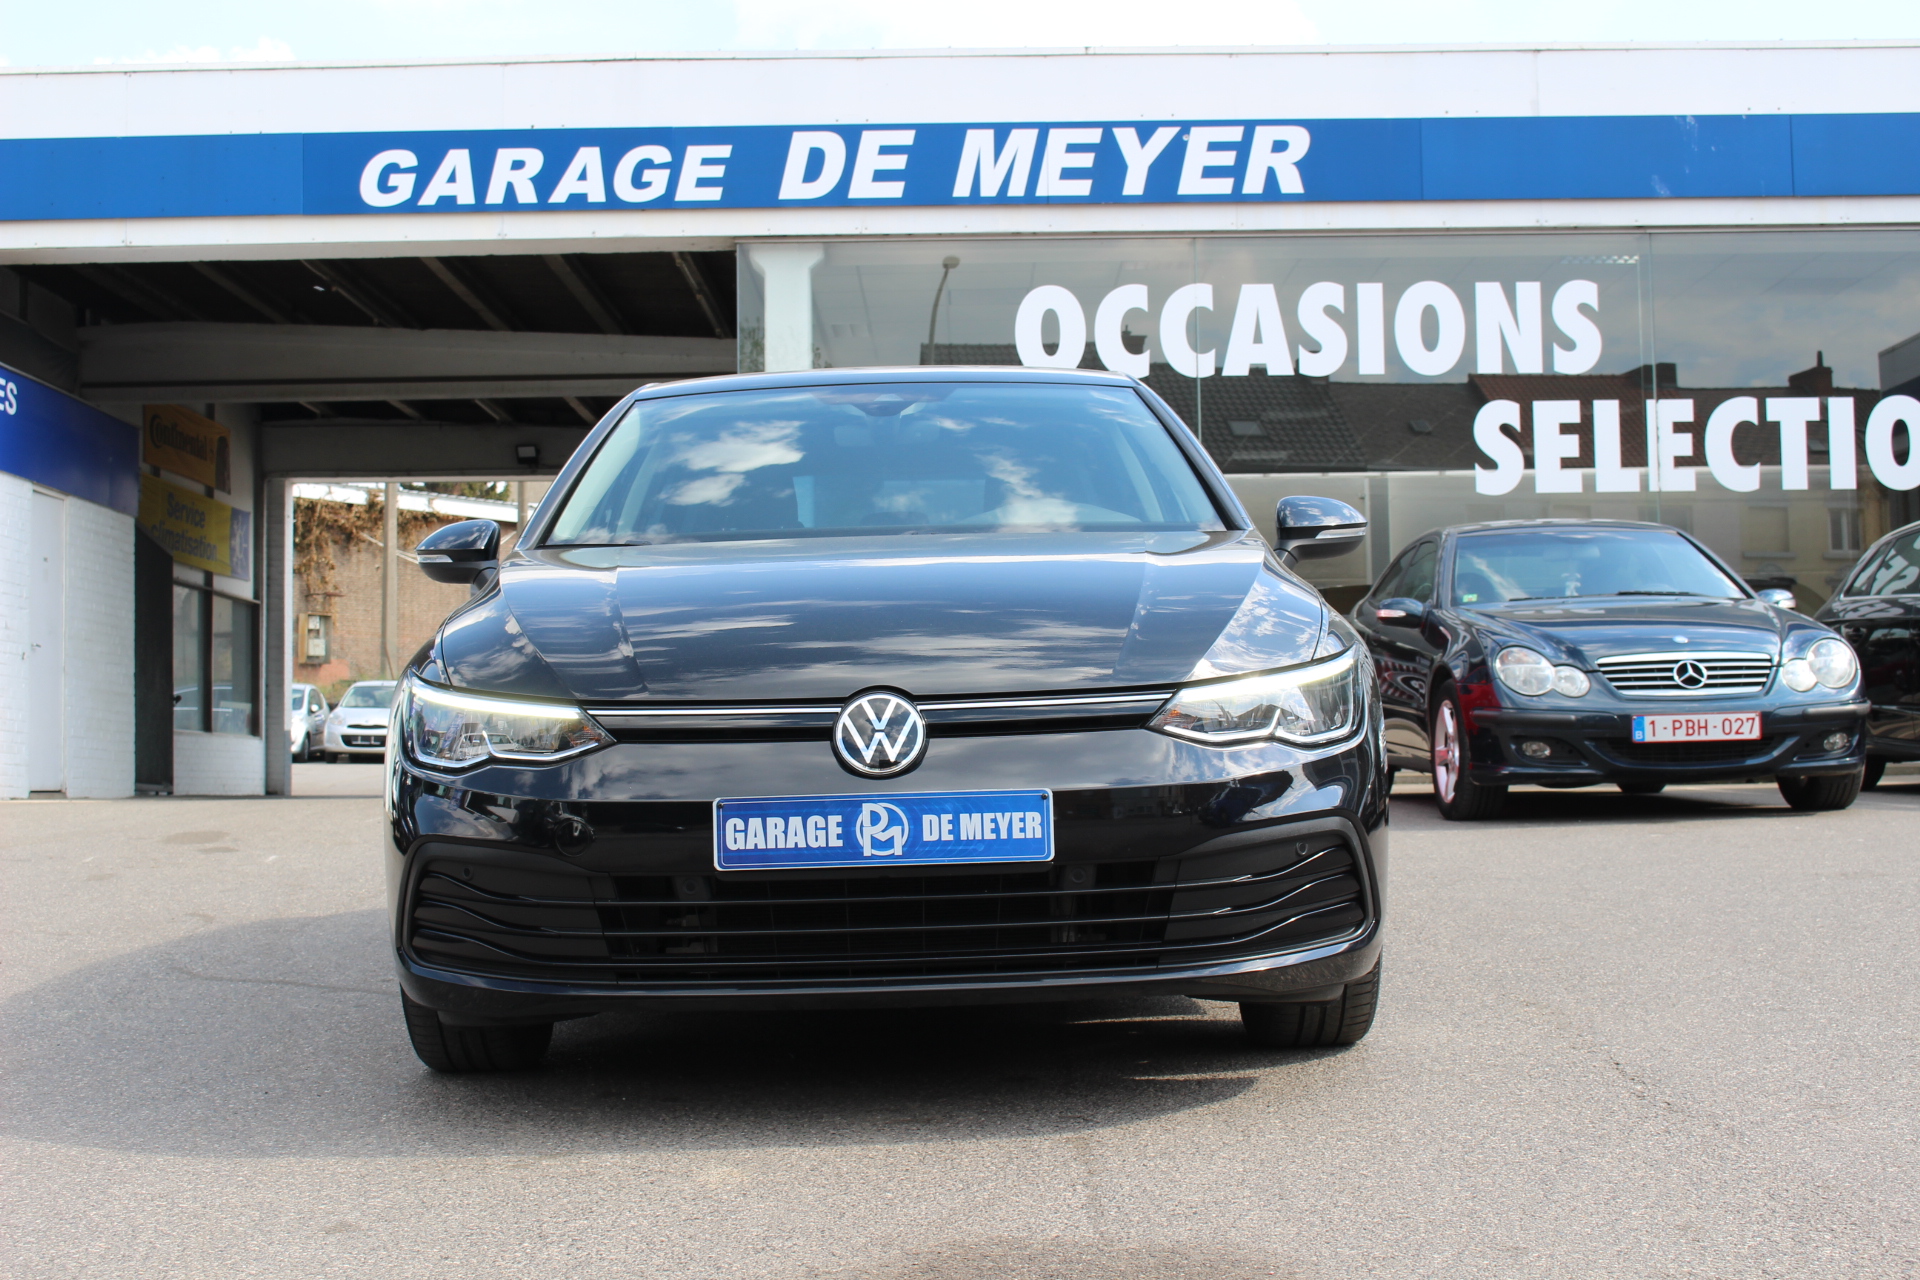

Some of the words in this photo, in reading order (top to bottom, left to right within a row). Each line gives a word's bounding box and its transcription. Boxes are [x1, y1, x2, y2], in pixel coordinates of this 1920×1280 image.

[358, 144, 733, 208] GARAGE
[778, 129, 916, 200] DE
[952, 125, 1311, 198] MEYER
[1014, 279, 1602, 379] OCCASIONS
[150, 414, 208, 461] Continental
[1472, 394, 1920, 496] SELECTIO
[166, 492, 206, 529] Service
[151, 521, 219, 563] climatisation
[725, 815, 843, 851] GARAGE
[922, 814, 954, 841] DE
[959, 811, 1042, 840] MEYER
